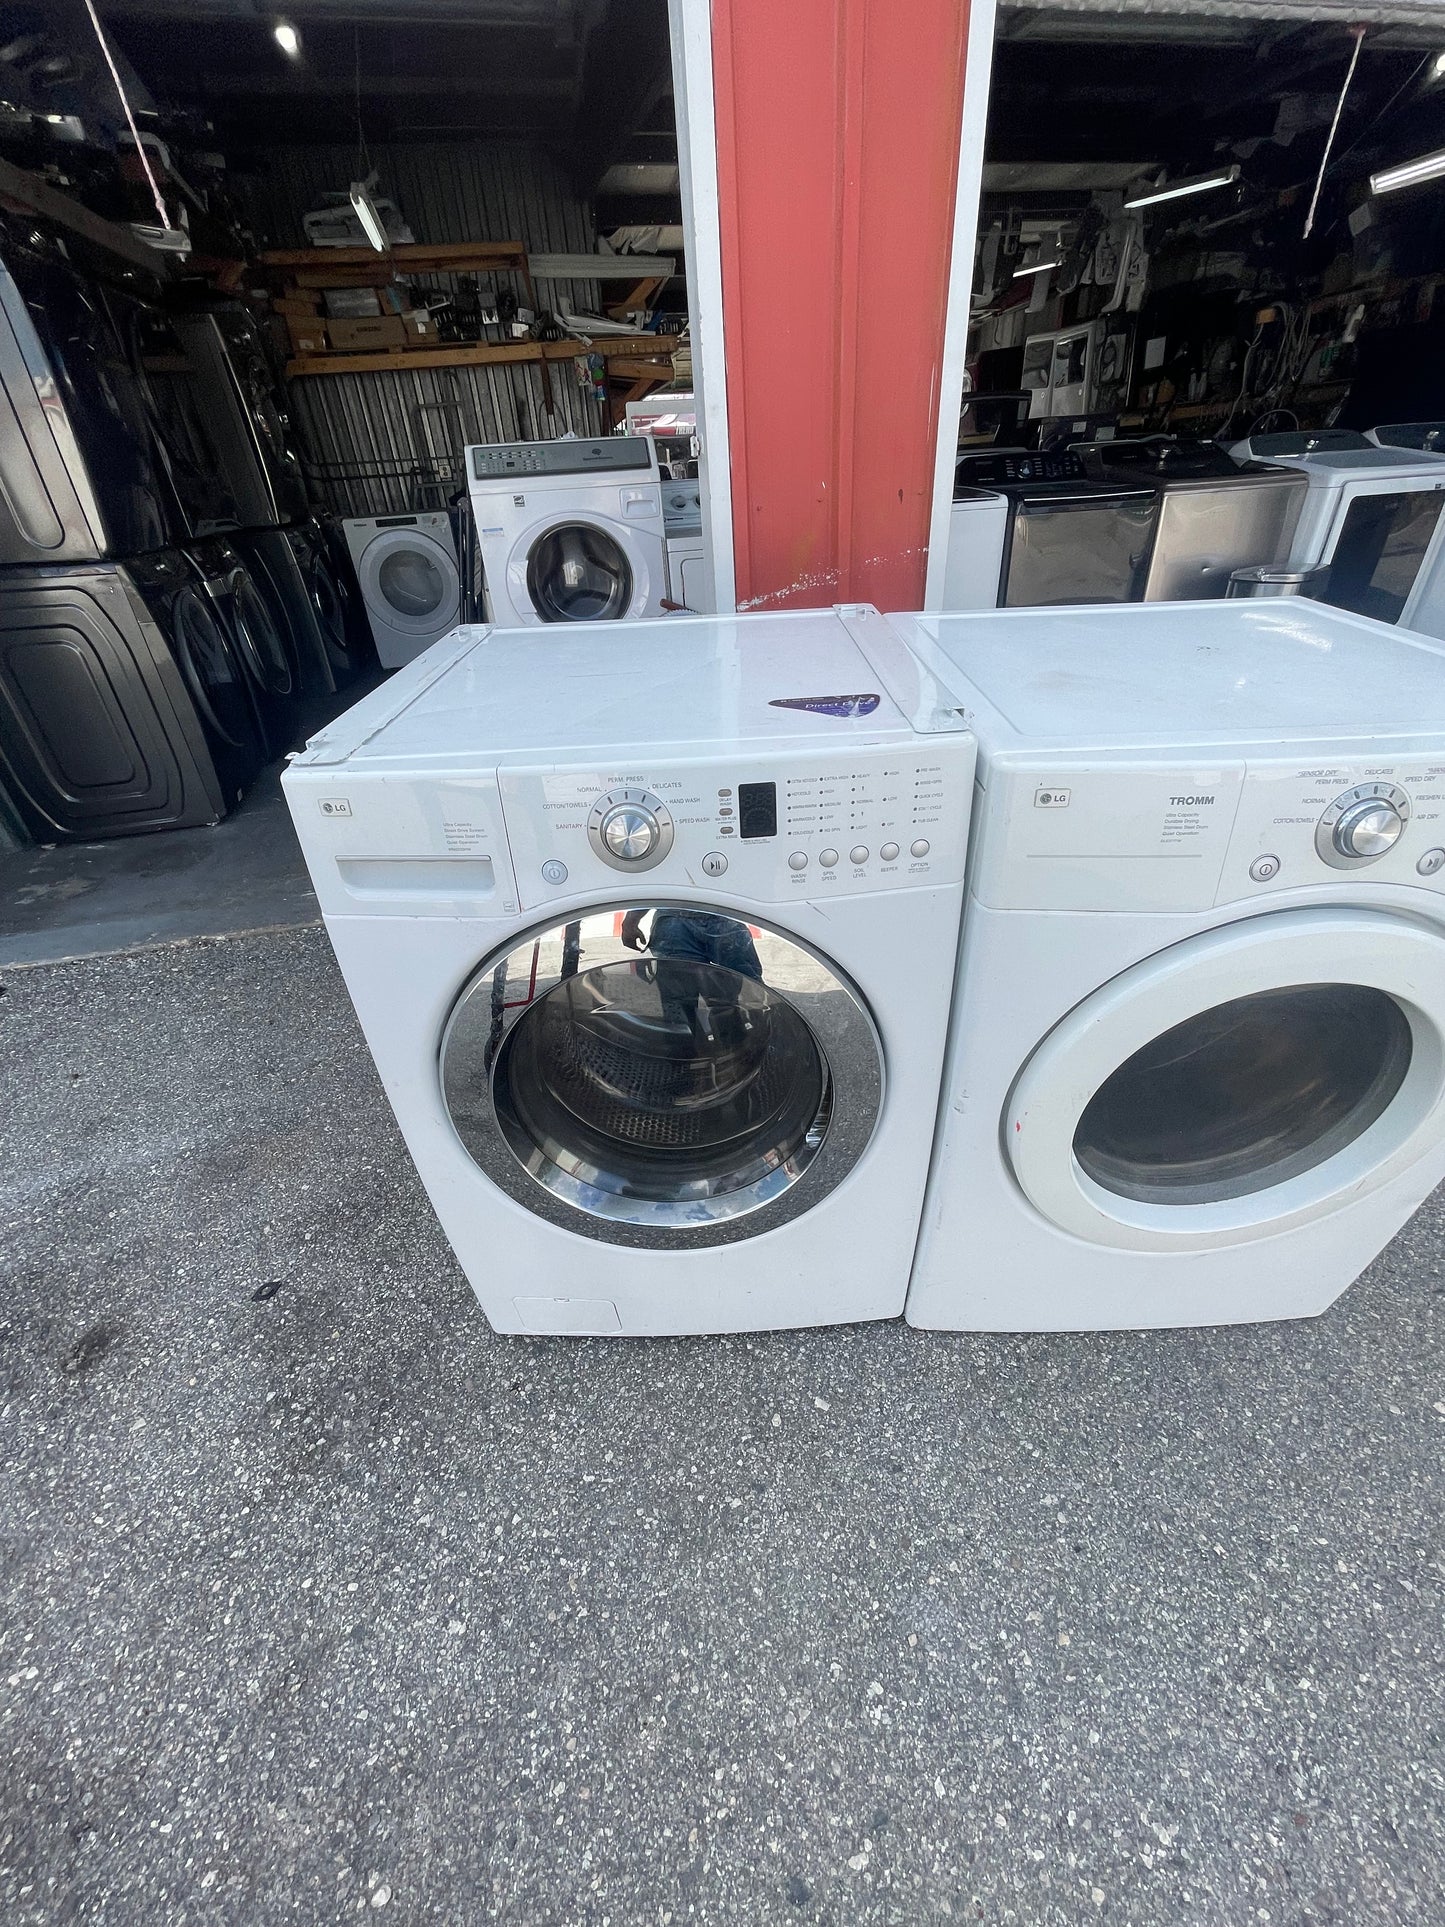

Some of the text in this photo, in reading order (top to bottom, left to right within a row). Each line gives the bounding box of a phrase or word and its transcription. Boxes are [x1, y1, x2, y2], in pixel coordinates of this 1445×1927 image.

[1053, 794, 1066, 802] LG
[1169, 796, 1215, 805] TROMM
[334, 804, 346, 812] LG
